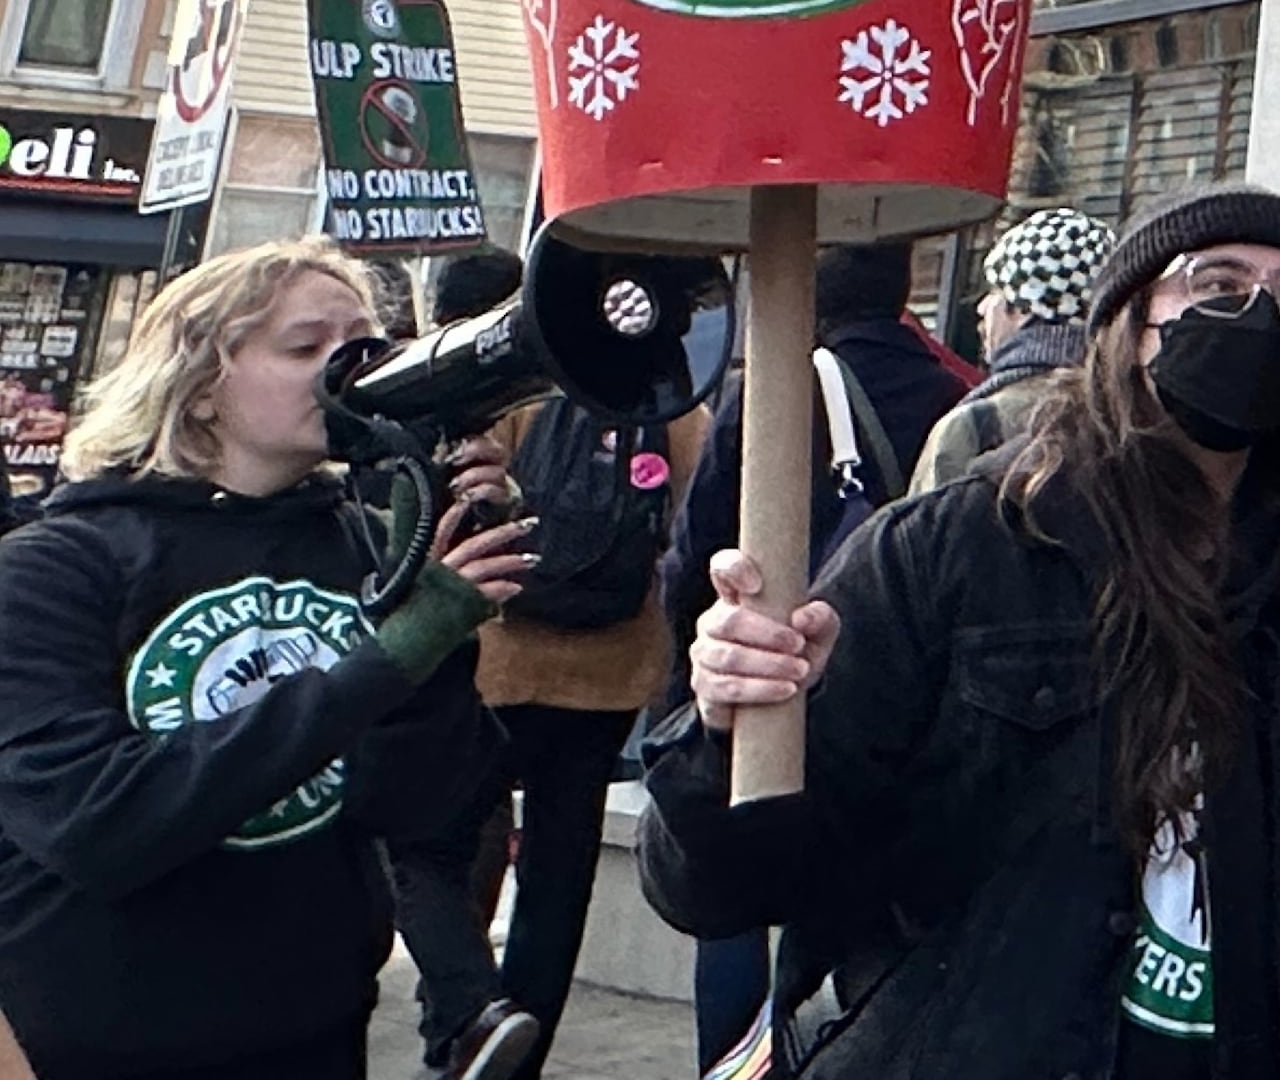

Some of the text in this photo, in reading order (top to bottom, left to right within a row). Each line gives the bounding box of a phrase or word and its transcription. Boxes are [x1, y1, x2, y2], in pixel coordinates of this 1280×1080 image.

[311, 39, 455, 83] ULP STRIKE
[0, 126, 96, 180] eli
[328, 169, 477, 201] NO CONTRACT,
[334, 208, 364, 240] NO
